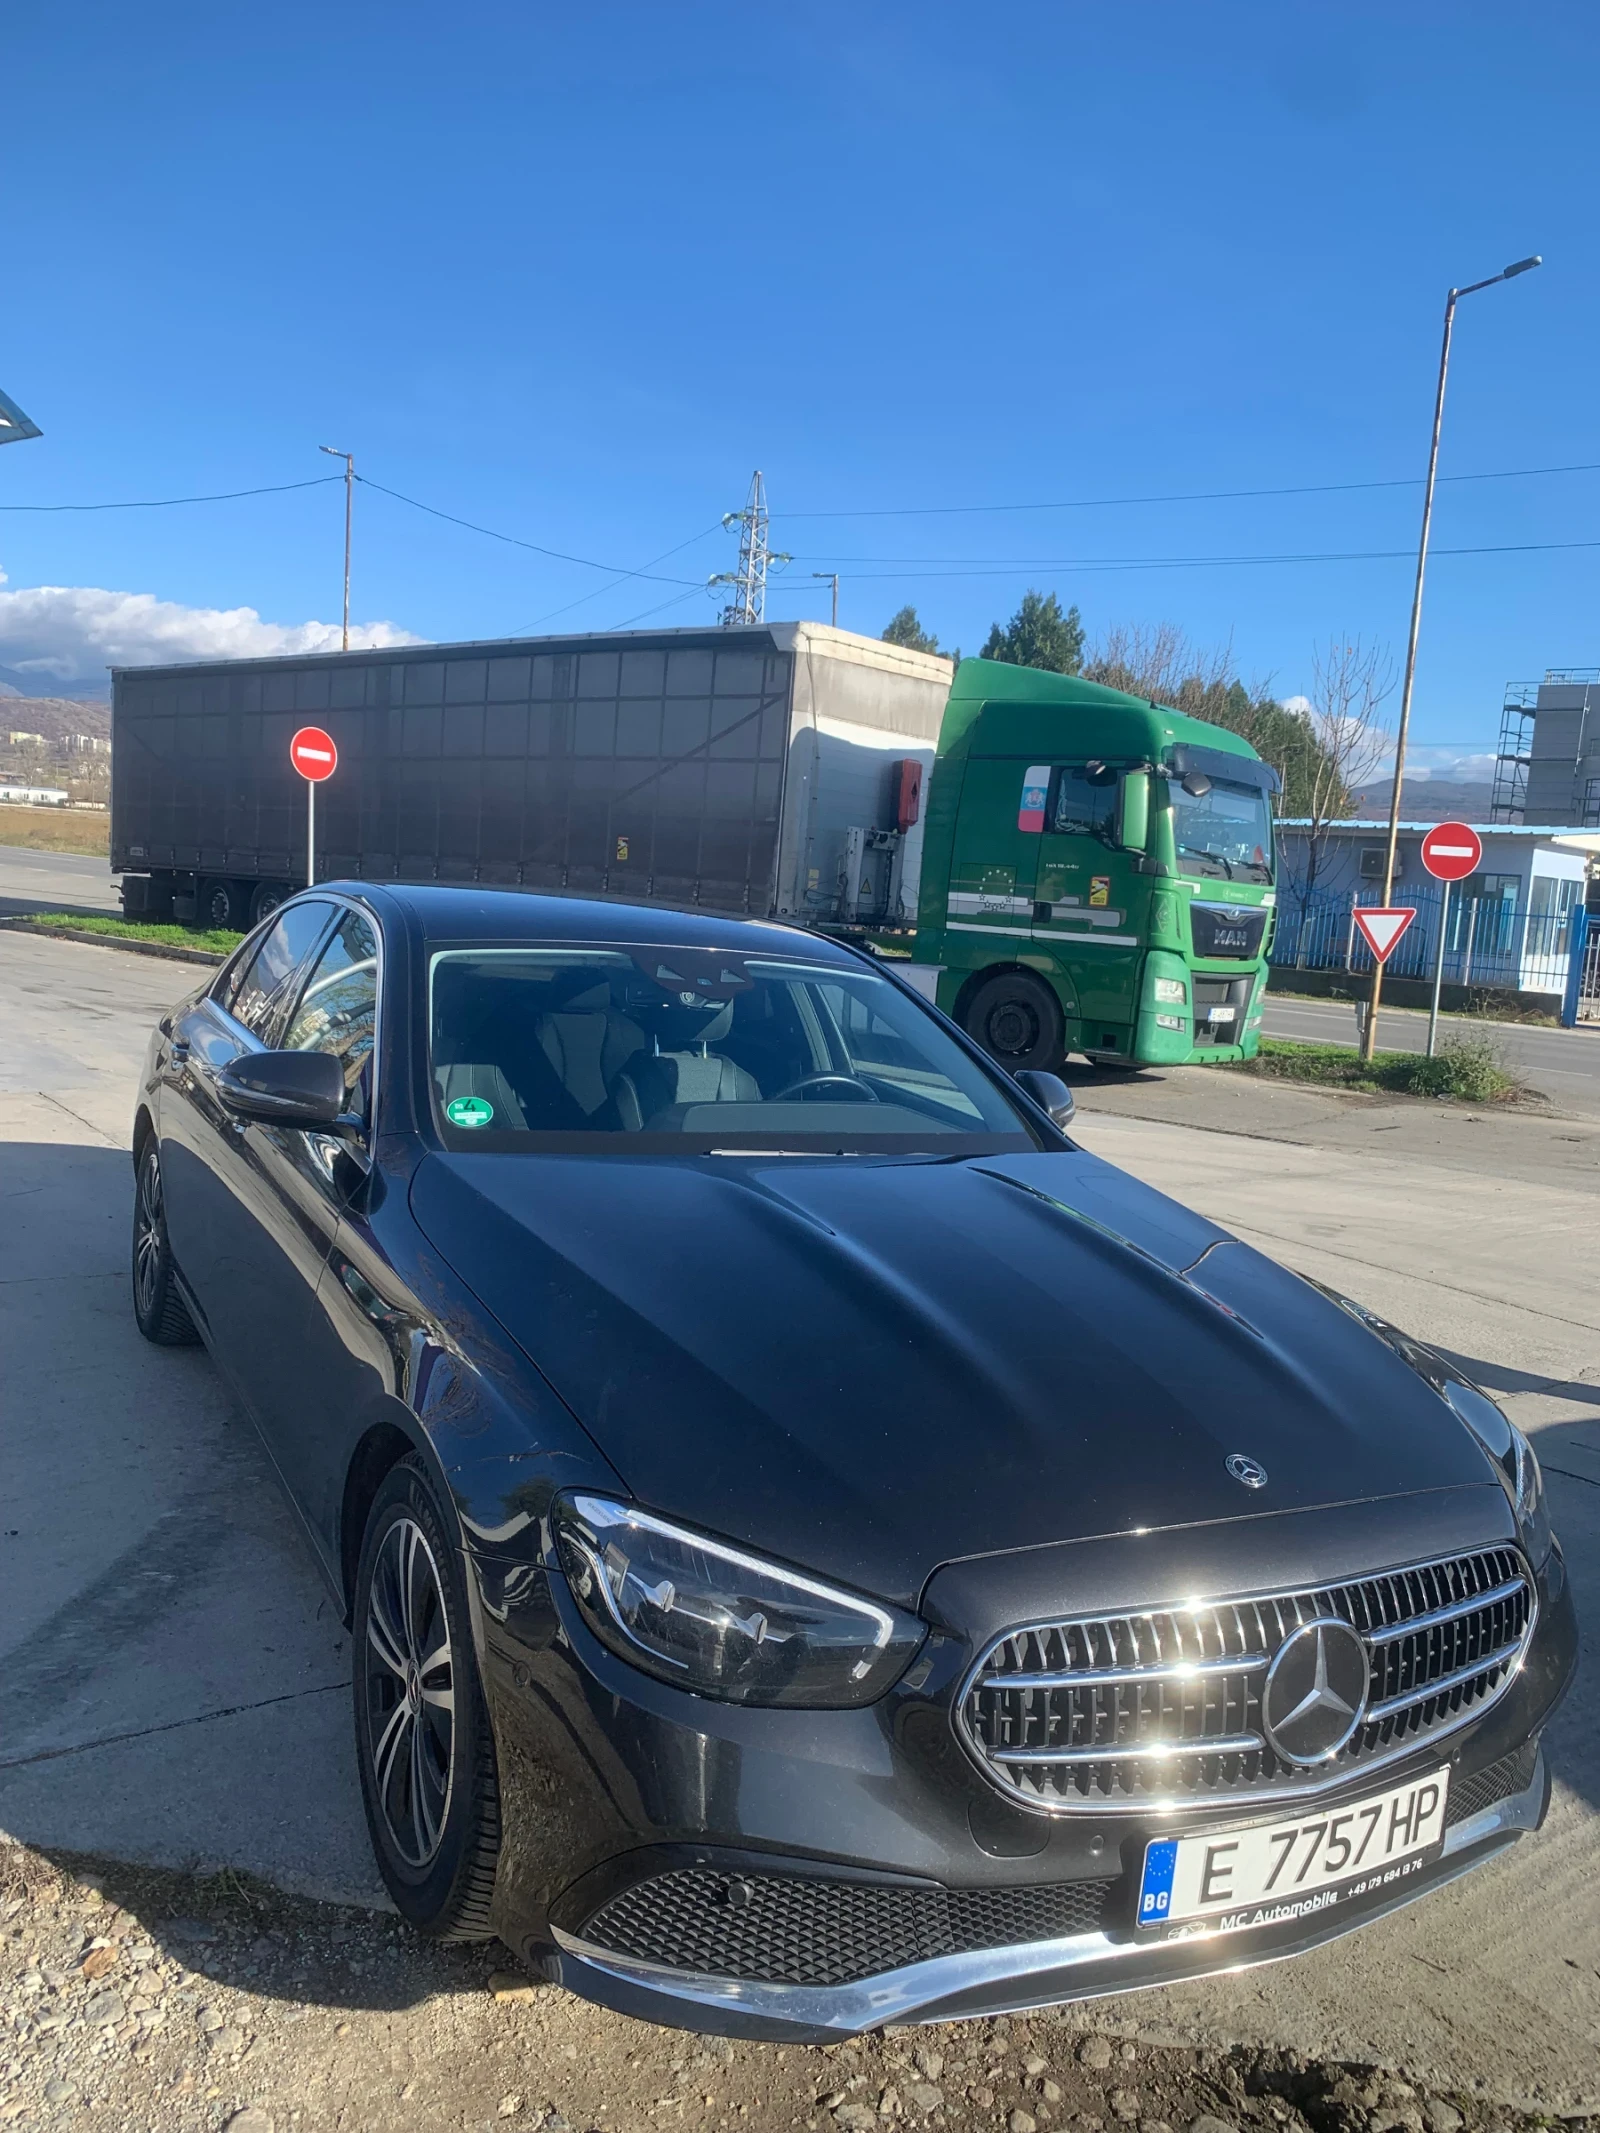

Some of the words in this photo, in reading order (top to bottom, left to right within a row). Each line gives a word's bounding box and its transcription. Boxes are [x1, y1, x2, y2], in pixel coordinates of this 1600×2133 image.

[1214, 929, 1247, 946] MAN
[464, 1099, 476, 1111] 4
[1199, 1841, 1239, 1904] E
[1264, 1804, 1383, 1891] 7757
[1385, 1783, 1439, 1853] HP
[1143, 1891, 1168, 1912] BG
[1220, 1912, 1248, 1930] MC
[1251, 1891, 1339, 1924] Automobile
[1348, 1882, 1366, 1897] +49
[1368, 1876, 1382, 1890] 179
[1384, 1867, 1401, 1883] 684
[1402, 1863, 1410, 1875] 13
[1412, 1858, 1423, 1871] 76
